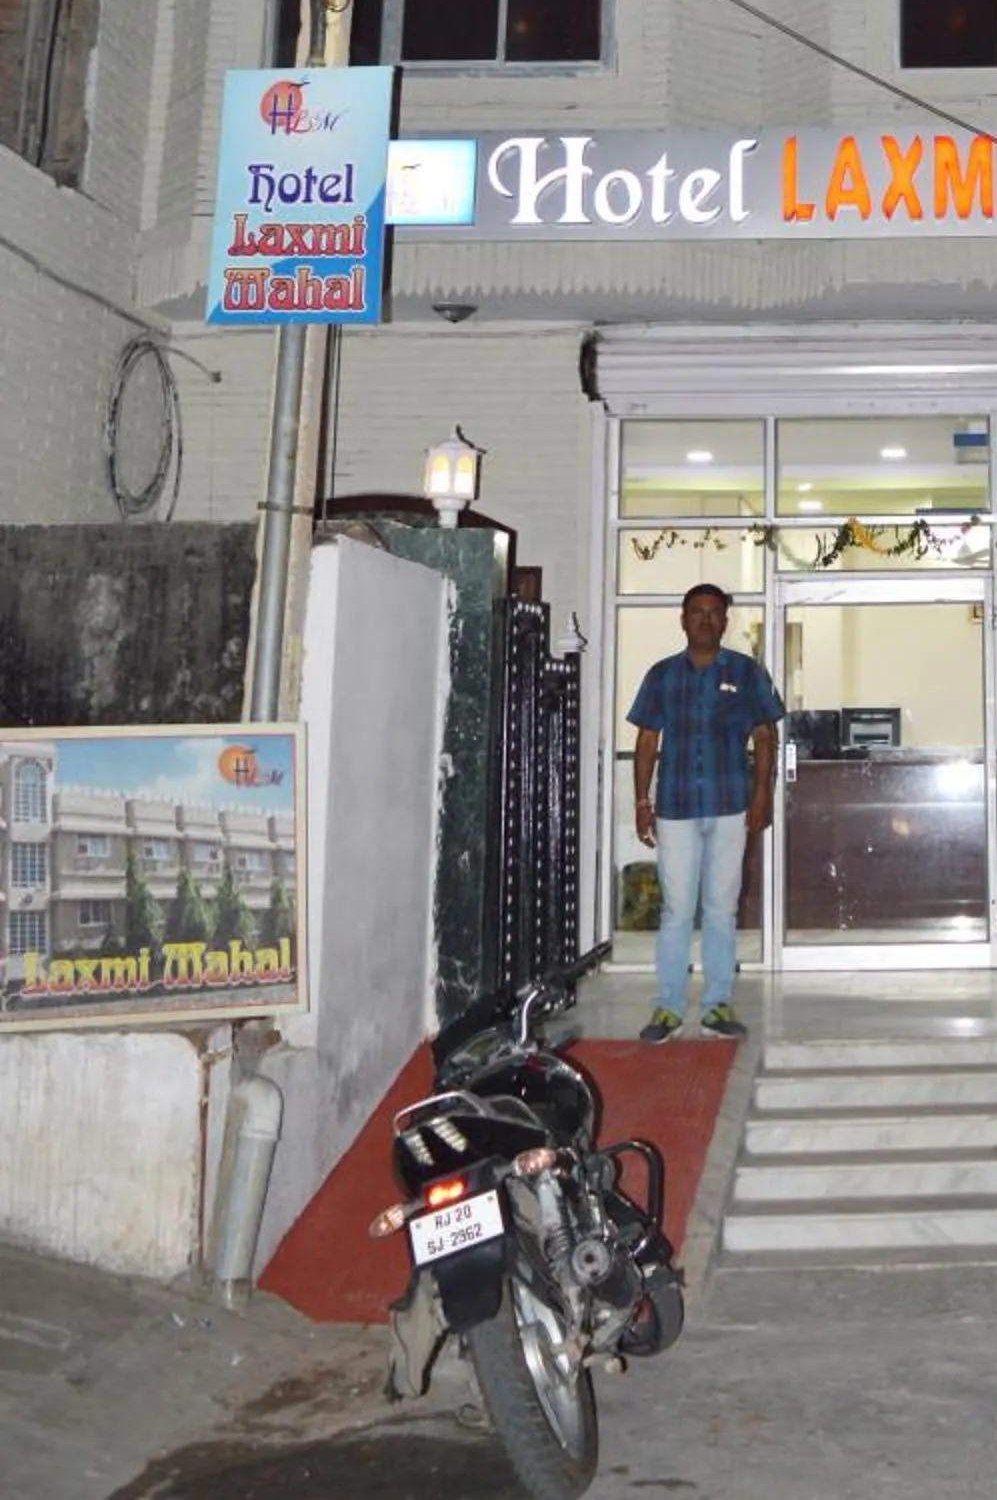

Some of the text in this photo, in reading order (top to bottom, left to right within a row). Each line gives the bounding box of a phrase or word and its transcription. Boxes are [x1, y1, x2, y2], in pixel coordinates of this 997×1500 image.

[487, 137, 758, 224] Hotel
[226, 213, 367, 257] Laxmi
[223, 265, 366, 311] Mahal
[20, 937, 292, 997] Laxmi Mahal
[434, 1204, 472, 1229] RJ 20
